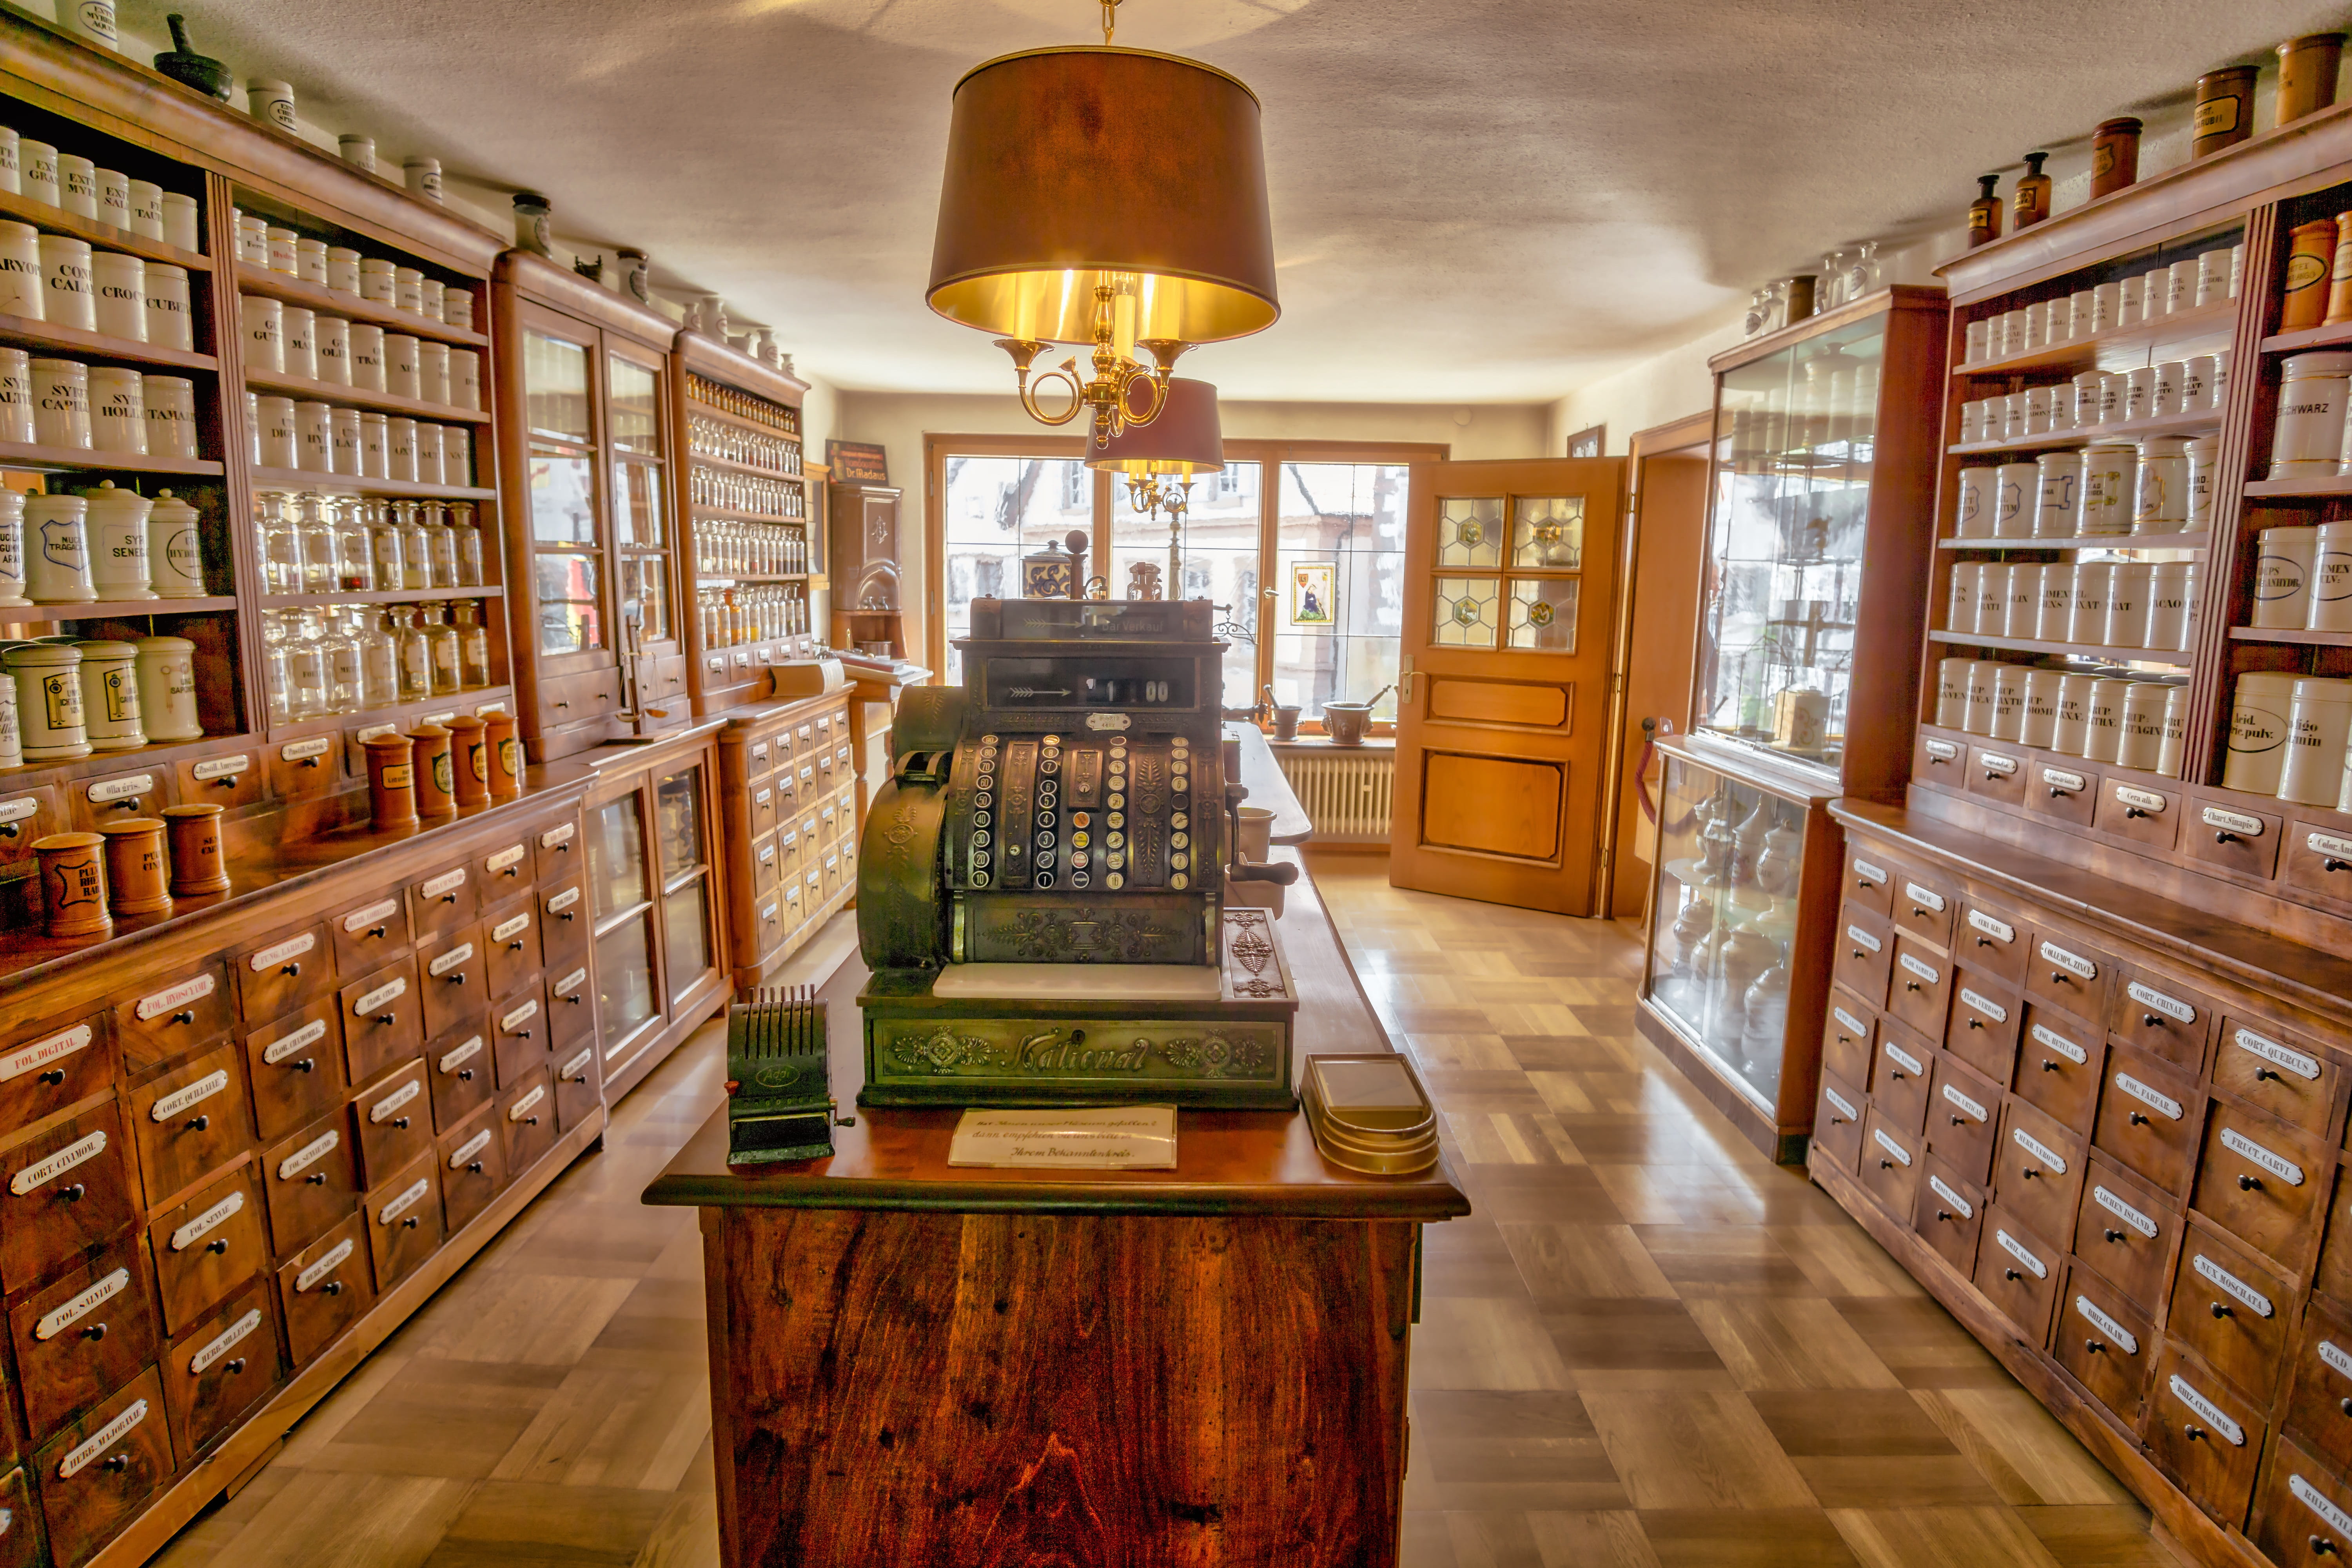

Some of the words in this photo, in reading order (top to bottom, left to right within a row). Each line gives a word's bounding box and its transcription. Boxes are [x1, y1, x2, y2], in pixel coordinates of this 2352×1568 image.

[856, 468, 886, 481] Madaus
[1123, 620, 1164, 633] Verkauf
[1107, 681, 1114, 702] 1
[1145, 681, 1169, 702] 00
[106, 785, 120, 795] Olla
[122, 783, 141, 793] gris.
[2127, 792, 2140, 803] Cera
[2141, 796, 2152, 806] alb.
[977, 815, 985, 824] 40
[1043, 815, 1048, 824] 4
[2228, 816, 2253, 829] Sinapis
[977, 835, 985, 843] 30
[1043, 835, 1048, 844] 3
[977, 855, 985, 864] 20
[1041, 855, 1049, 864] 2
[977, 875, 984, 884] 10
[1044, 876, 1046, 885] 1
[1978, 918, 1991, 930] CERA
[1991, 924, 2002, 935] ALBA
[1904, 957, 1915, 969] FLOR.
[1915, 963, 1934, 979] SAMBUCI
[2044, 947, 2073, 967] COLLEMPL.
[2073, 961, 2091, 975] ZINCI
[147, 999, 165, 1013] FOL.
[166, 981, 206, 1006] HYOSCYAMI
[1964, 993, 1977, 1006] FLOR.
[1978, 999, 2003, 1018] VERBASCI
[2136, 988, 2155, 1004] CORT.
[2156, 997, 2184, 1016] CHINAE
[15, 1055, 37, 1069] FOL.
[38, 1037, 77, 1059] DIGITAL.
[999, 1027, 1149, 1072] National
[2039, 1030, 2050, 1043] FOL.
[2051, 1037, 2079, 1058] BETULAE
[2243, 1036, 2266, 1053] CORT.
[2268, 1047, 2309, 1072] QUERCUS
[163, 1096, 184, 1114] CORT.
[1947, 1089, 1961, 1103] HERB.
[1961, 1098, 1983, 1117] URTICAE
[2125, 1079, 2140, 1094] FOL.
[2141, 1088, 2171, 1112] FARFAR.
[1010, 1147, 1045, 1157] Ihrem
[1048, 1148, 1135, 1158] Bekanntenkreis.
[2035, 1144, 2061, 1169] VERONIC.
[2231, 1136, 2261, 1160] FRUCT.
[2262, 1154, 2289, 1176] CARVI
[27, 1165, 55, 1184] CORT.
[1934, 1181, 1951, 1200] RESINA
[1951, 1193, 1968, 1214] JALAP.
[2099, 1191, 2123, 1213] LICHEN
[2123, 1208, 2151, 1232] ISLAND.
[190, 1222, 205, 1237] FOL.
[2020, 1248, 2036, 1269] ASARI
[2201, 1261, 2217, 1279] NUX
[2220, 1273, 2263, 1310] MOSCHATA
[56, 1308, 79, 1327] FOL.
[2088, 1308, 2103, 1327] RHIZ.
[2104, 1320, 2124, 1343] CALAM.
[201, 1343, 223, 1364] HERB.
[2326, 1348, 2349, 1370] RAD.
[2177, 1384, 2195, 1405] RHIZ.
[2195, 1398, 2231, 1434] CURCUMAE
[70, 1443, 97, 1469] HERB.
[2303, 1489, 2329, 1516] RHIZ.
